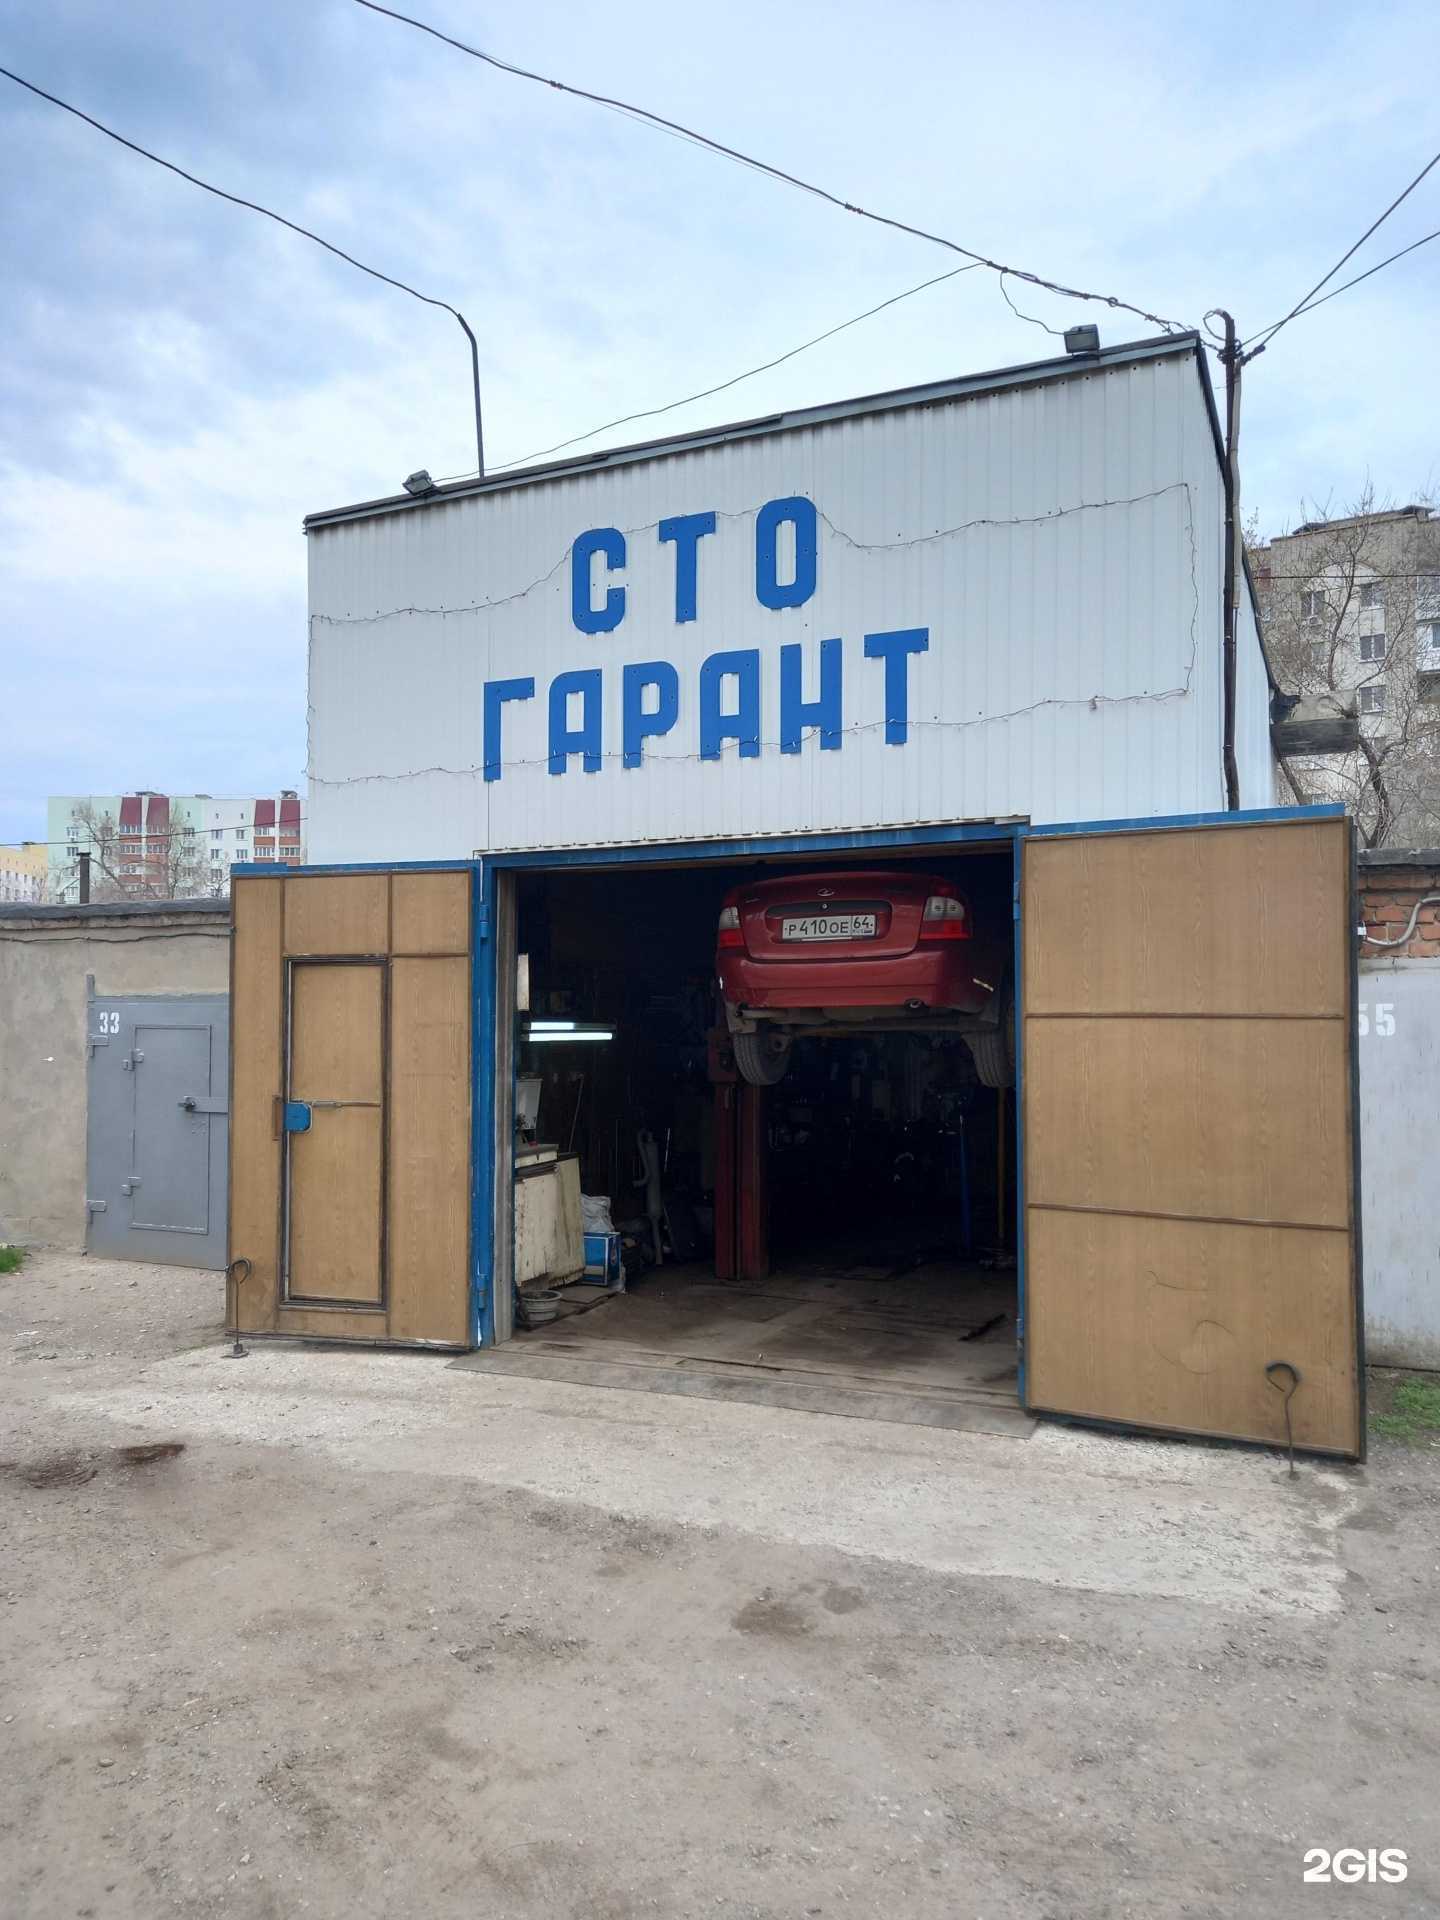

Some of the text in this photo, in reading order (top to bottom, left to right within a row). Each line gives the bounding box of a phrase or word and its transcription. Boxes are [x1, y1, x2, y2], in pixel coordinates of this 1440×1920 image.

[572, 496, 816, 634] СТО
[484, 627, 929, 781] ГАРАНТ
[99, 1012, 120, 1034] 33
